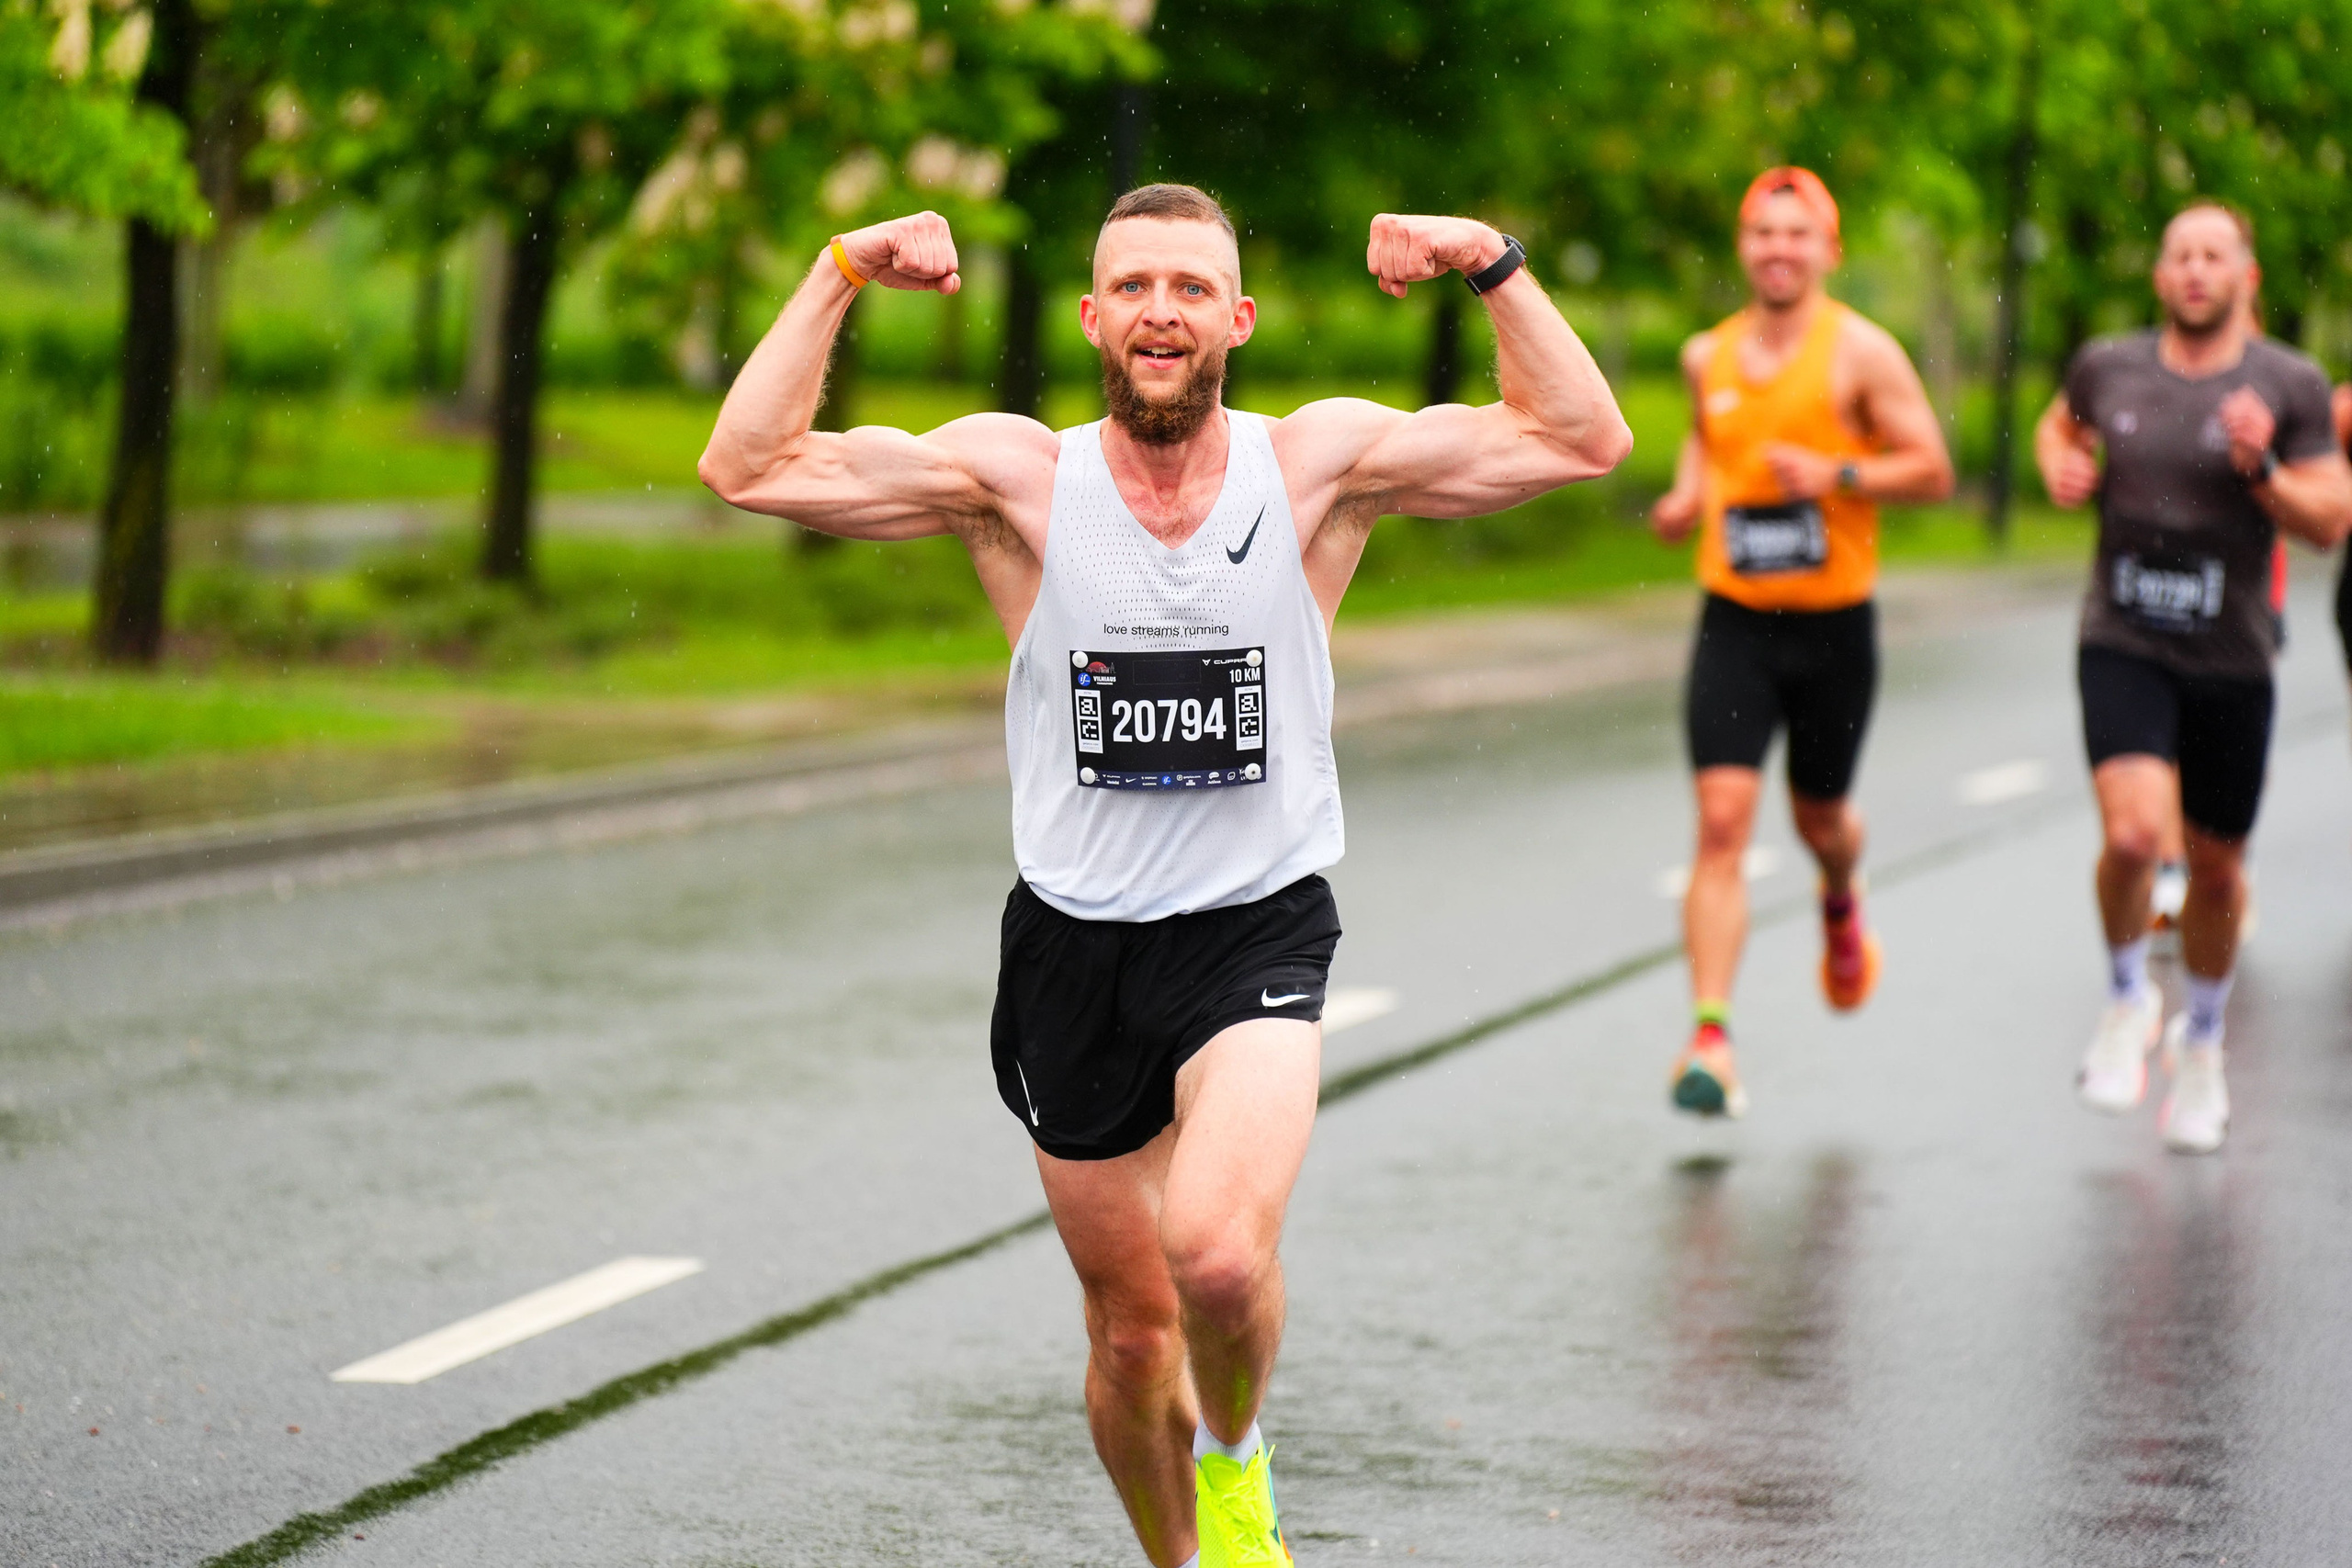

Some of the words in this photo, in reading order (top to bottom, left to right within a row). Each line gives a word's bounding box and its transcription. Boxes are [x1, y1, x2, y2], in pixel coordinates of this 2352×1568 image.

[1103, 624, 1127, 635] love
[1131, 626, 1180, 637] streams
[1183, 624, 1229, 636] running
[1229, 669, 1242, 682] 10
[1244, 667, 1261, 682] KM
[1112, 697, 1227, 743] 20794
